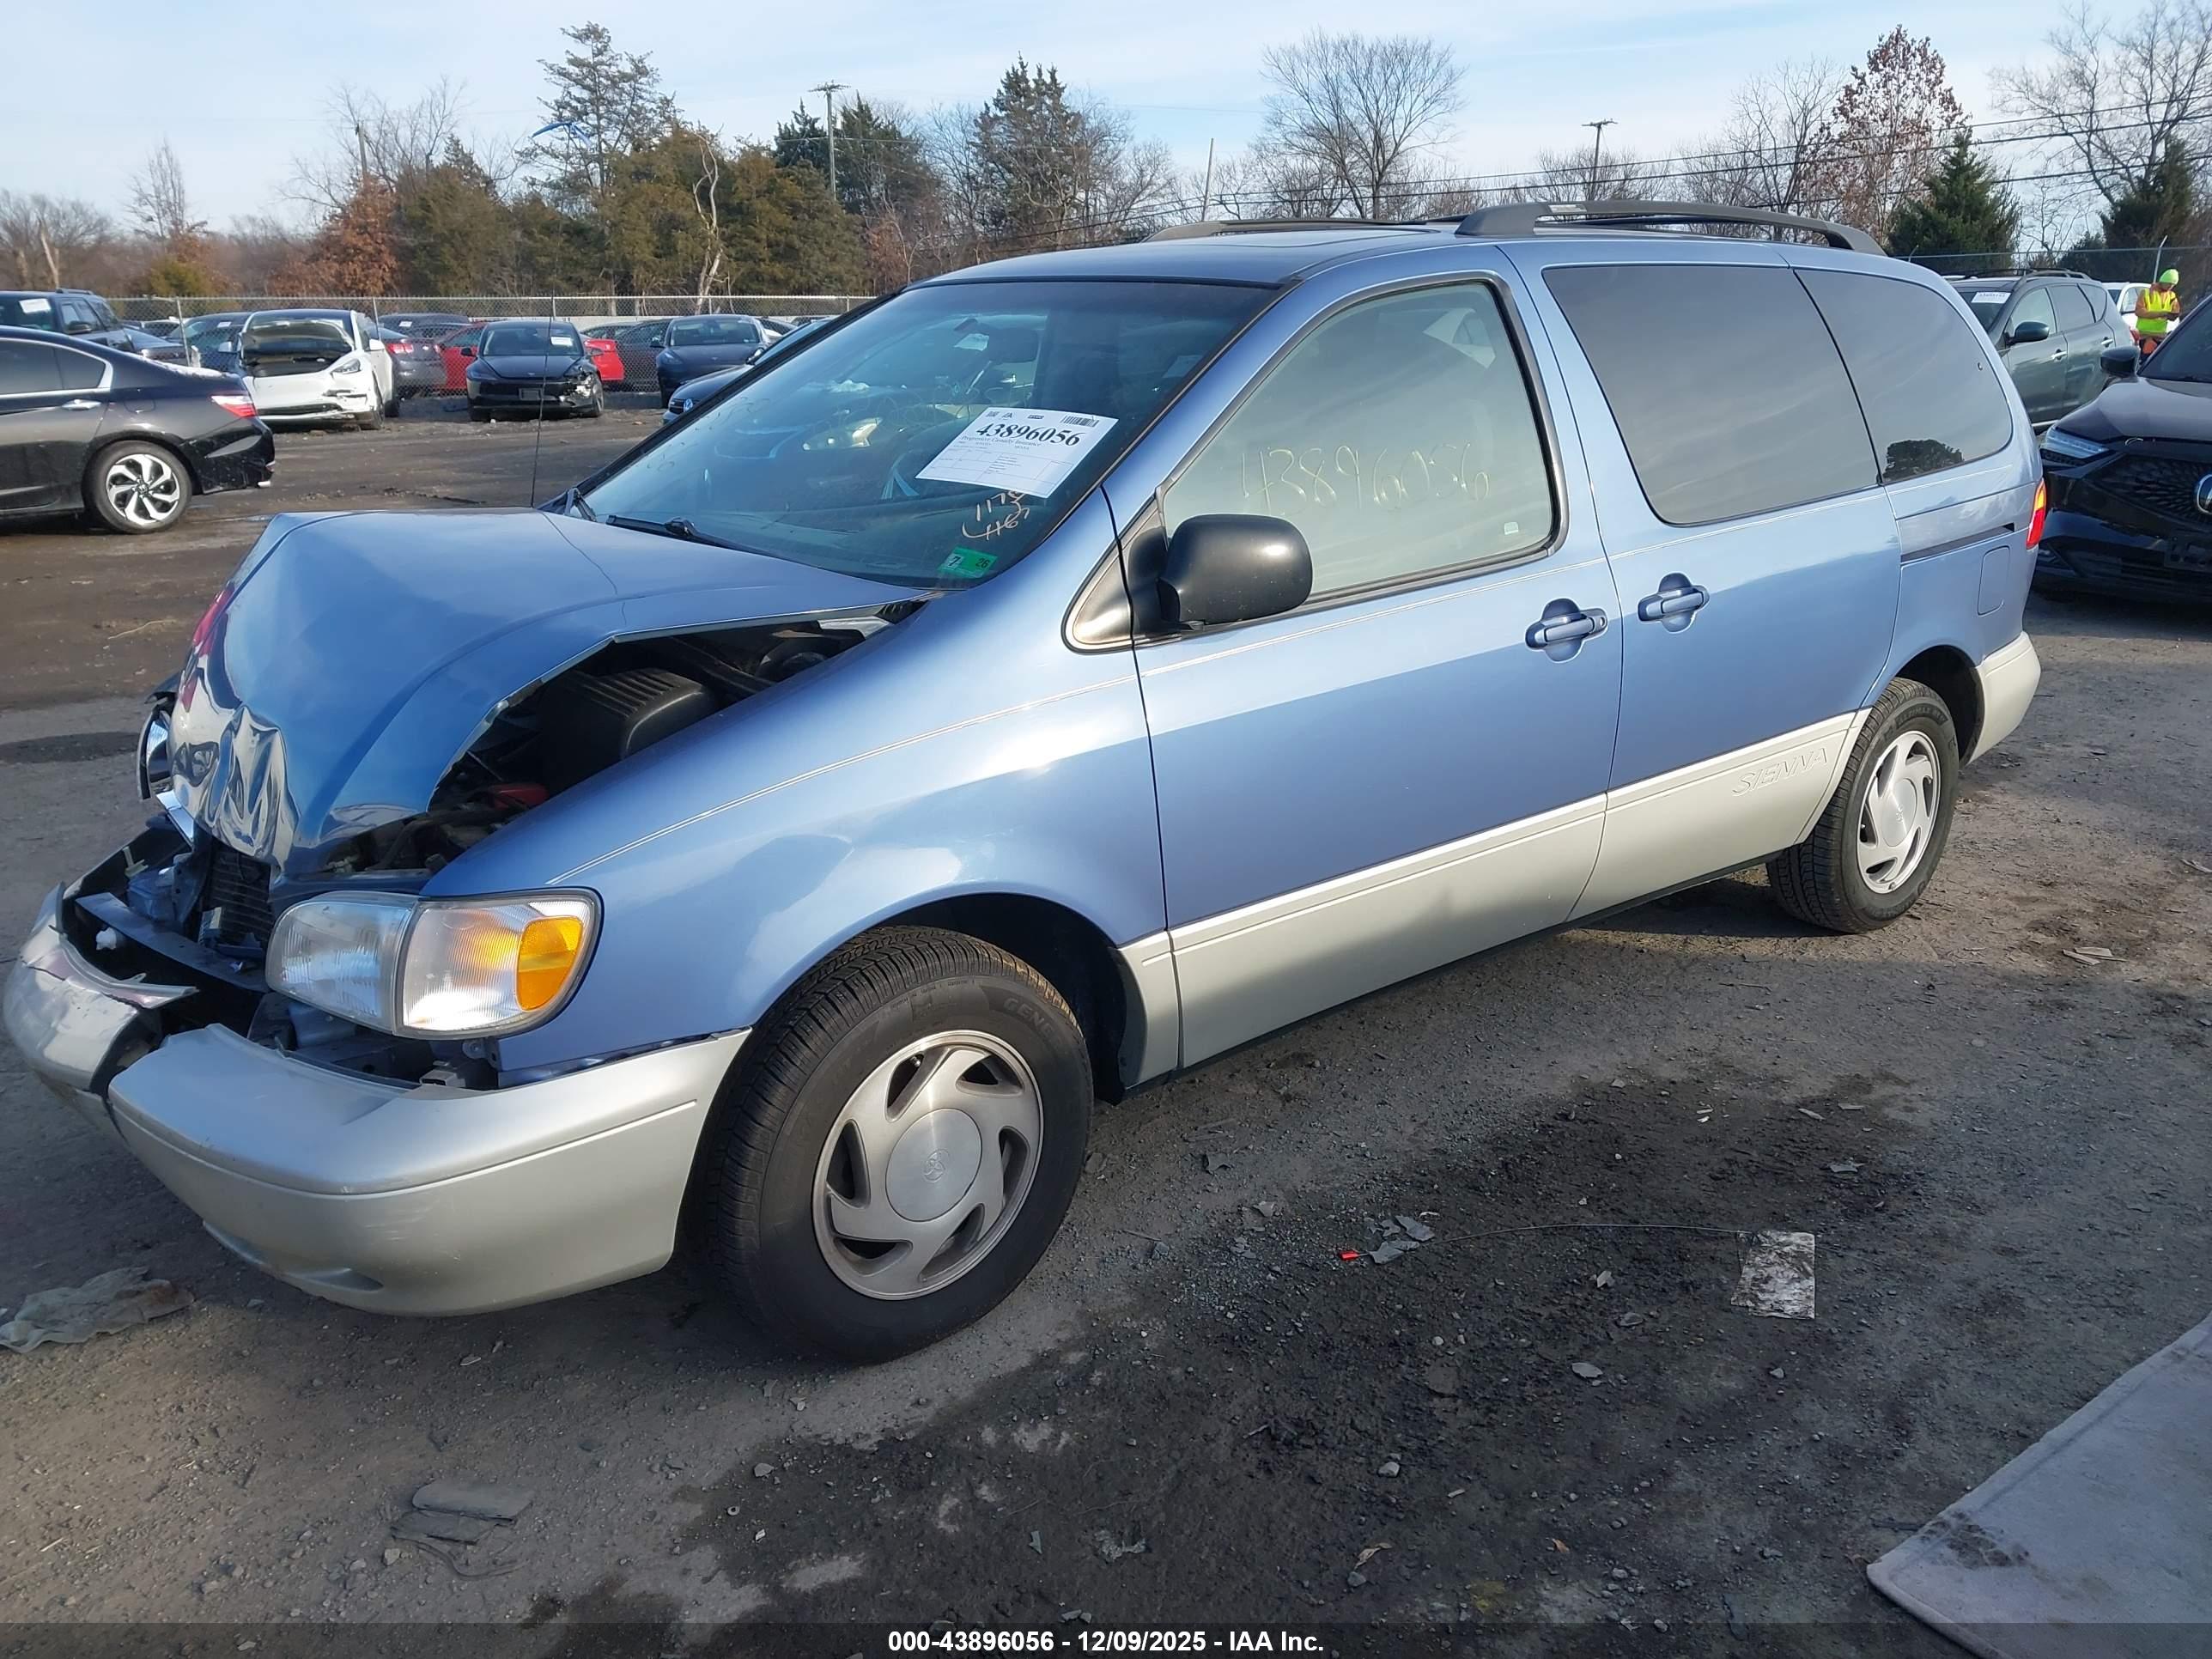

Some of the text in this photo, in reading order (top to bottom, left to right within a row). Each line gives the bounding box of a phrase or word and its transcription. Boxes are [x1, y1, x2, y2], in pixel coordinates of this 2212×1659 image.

[976, 422, 1085, 447] 43896056
[1242, 442, 1490, 516] 43896056
[947, 556, 990, 568] 7 26
[1731, 747, 1828, 798] SIENNA
